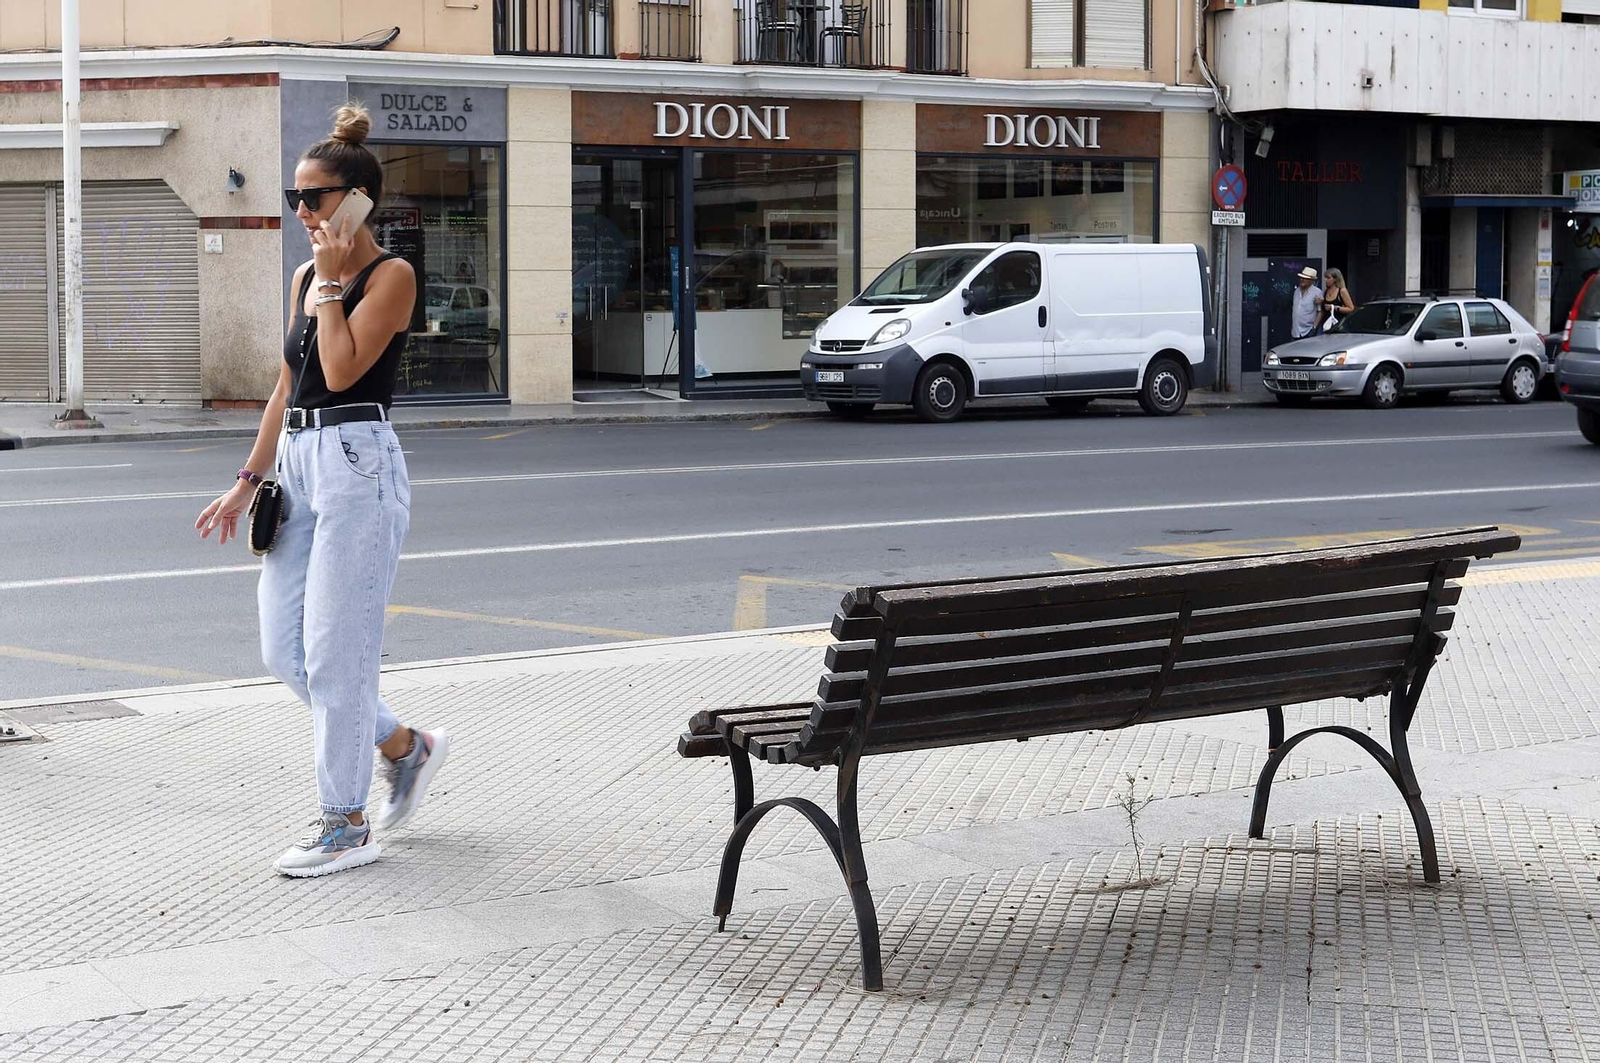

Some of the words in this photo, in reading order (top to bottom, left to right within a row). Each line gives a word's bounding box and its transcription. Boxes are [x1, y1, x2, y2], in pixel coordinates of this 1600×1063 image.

[381, 93, 447, 112] DULCE
[463, 97, 473, 112] &
[387, 113, 467, 132] SALADO
[653, 102, 790, 140] DIONI
[983, 113, 1101, 148] DIONI
[1277, 160, 1363, 183] TALLER
[1093, 220, 1117, 229] Postres
